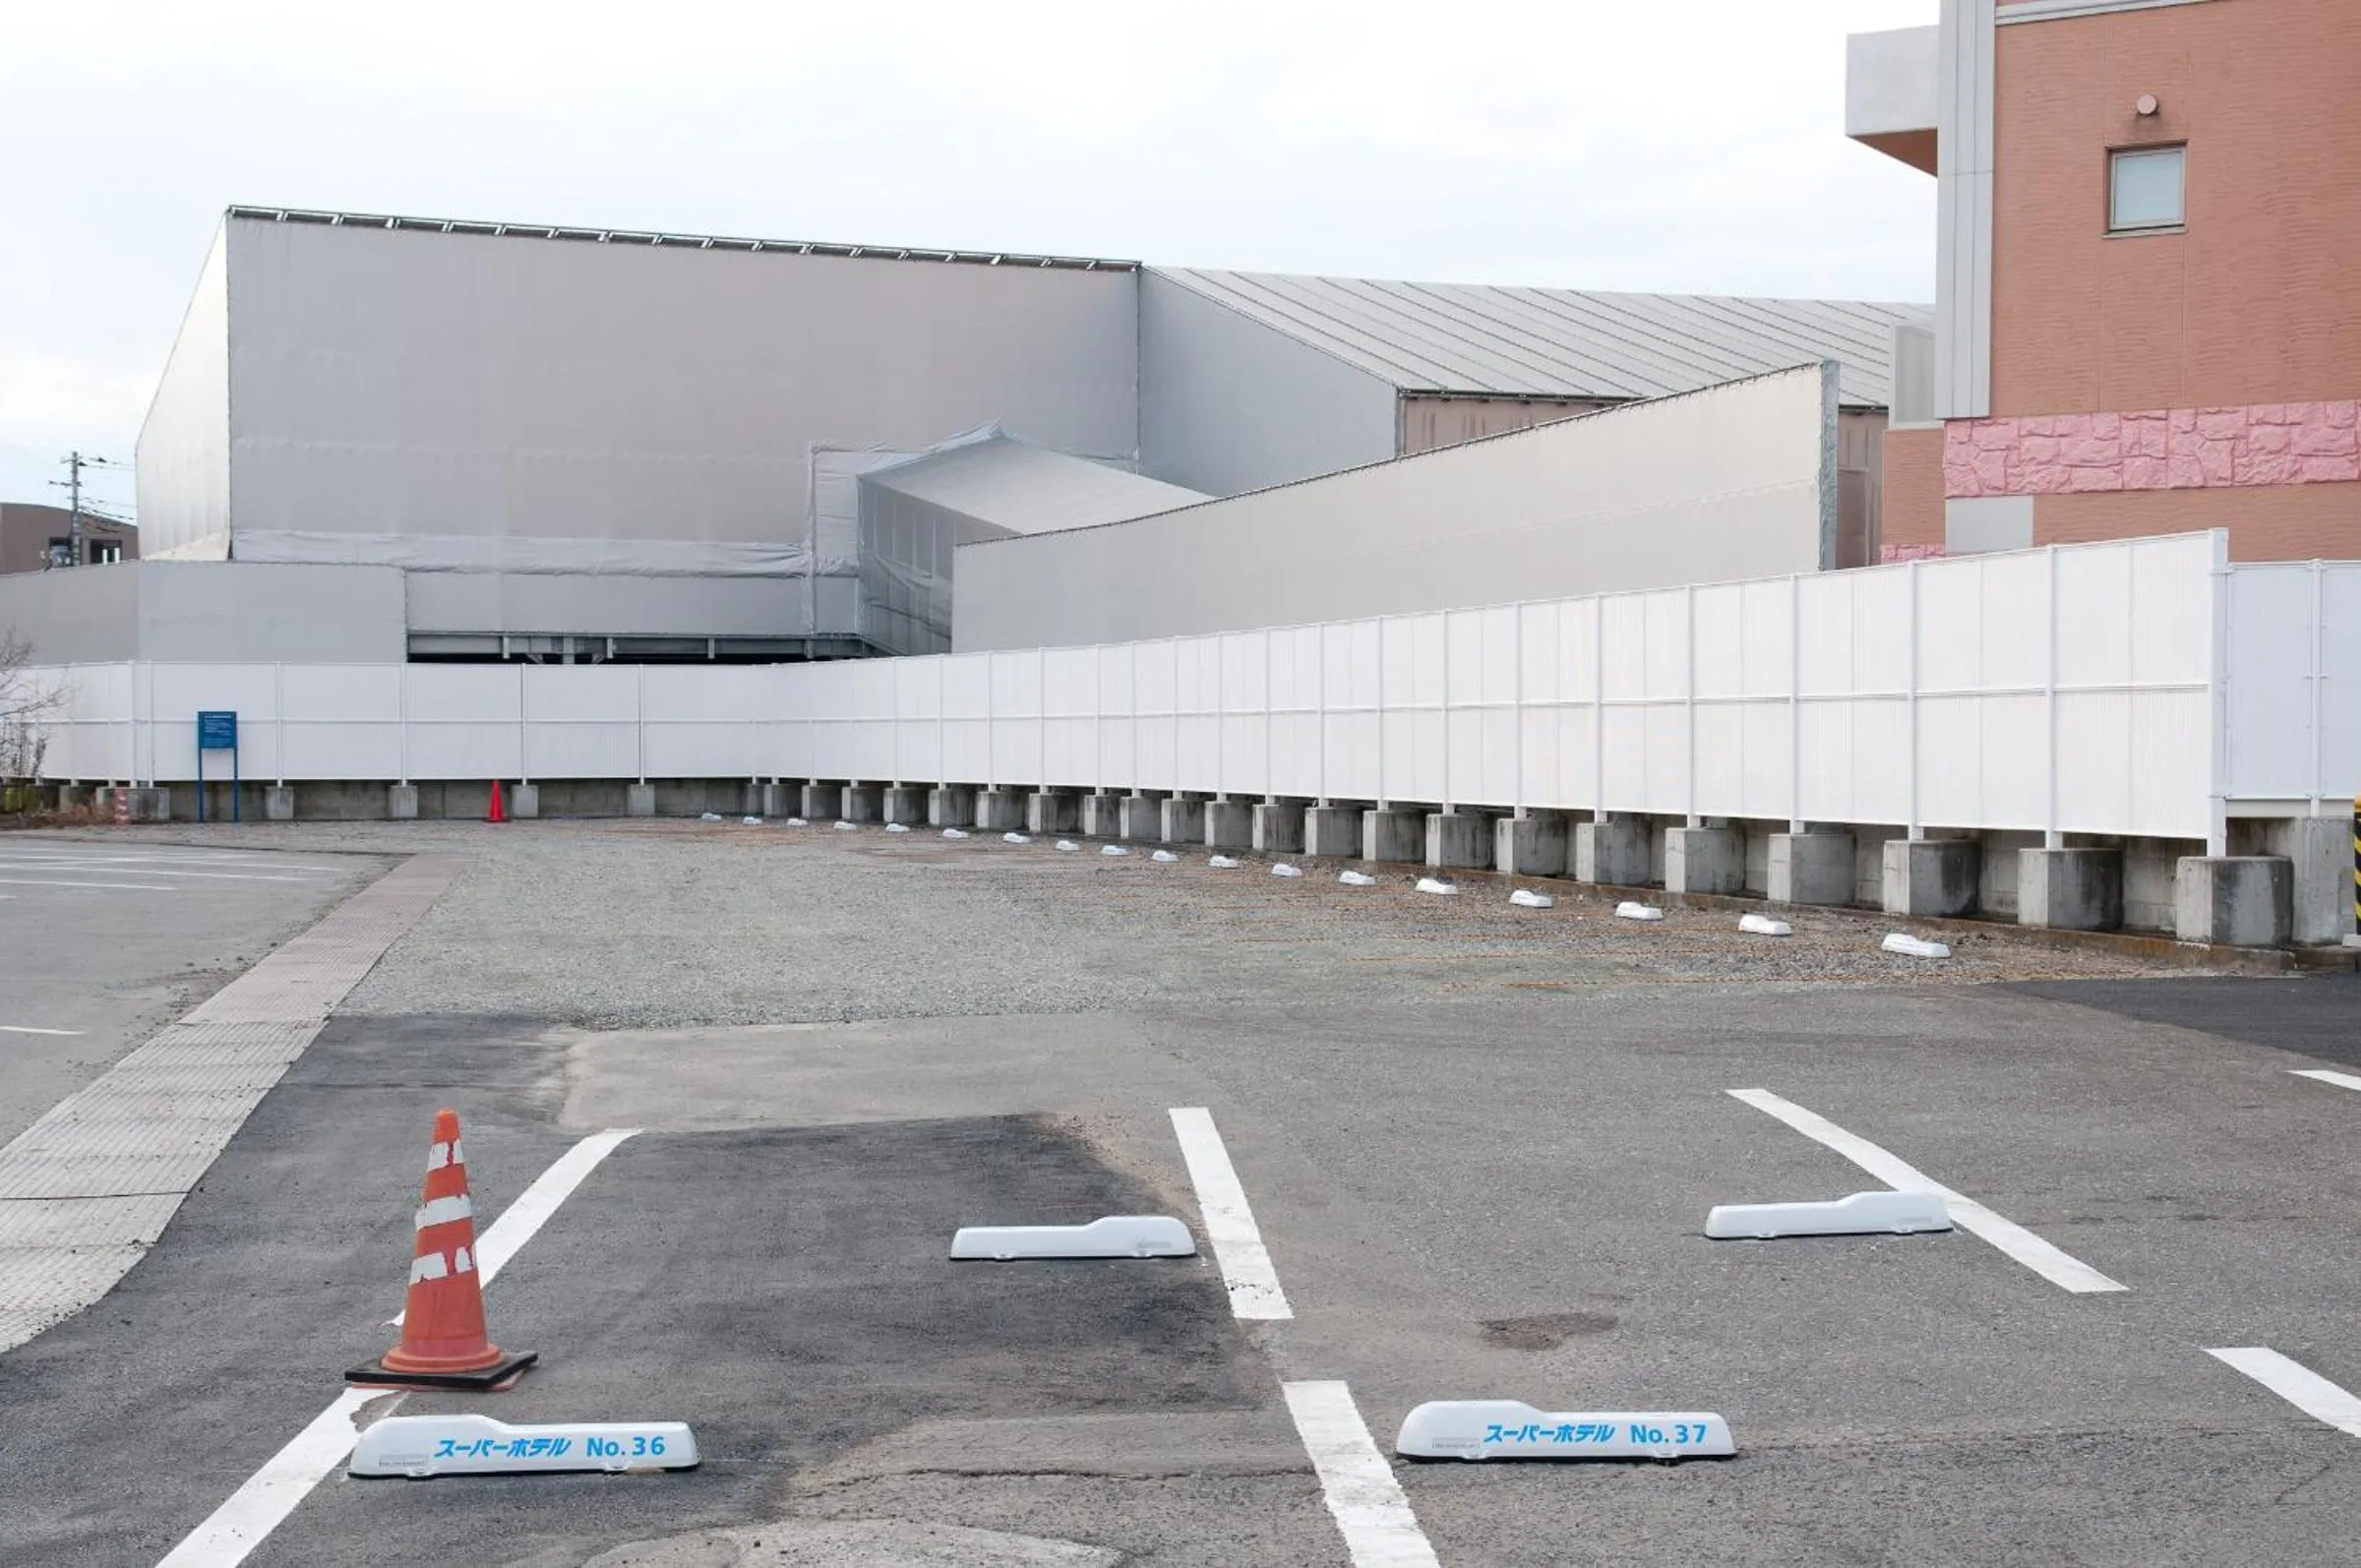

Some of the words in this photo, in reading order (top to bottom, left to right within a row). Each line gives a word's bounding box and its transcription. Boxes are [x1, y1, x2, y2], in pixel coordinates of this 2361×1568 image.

[1483, 1423, 1616, 1444] スーパーホテル
[434, 1437, 573, 1459] スーパーホテル
